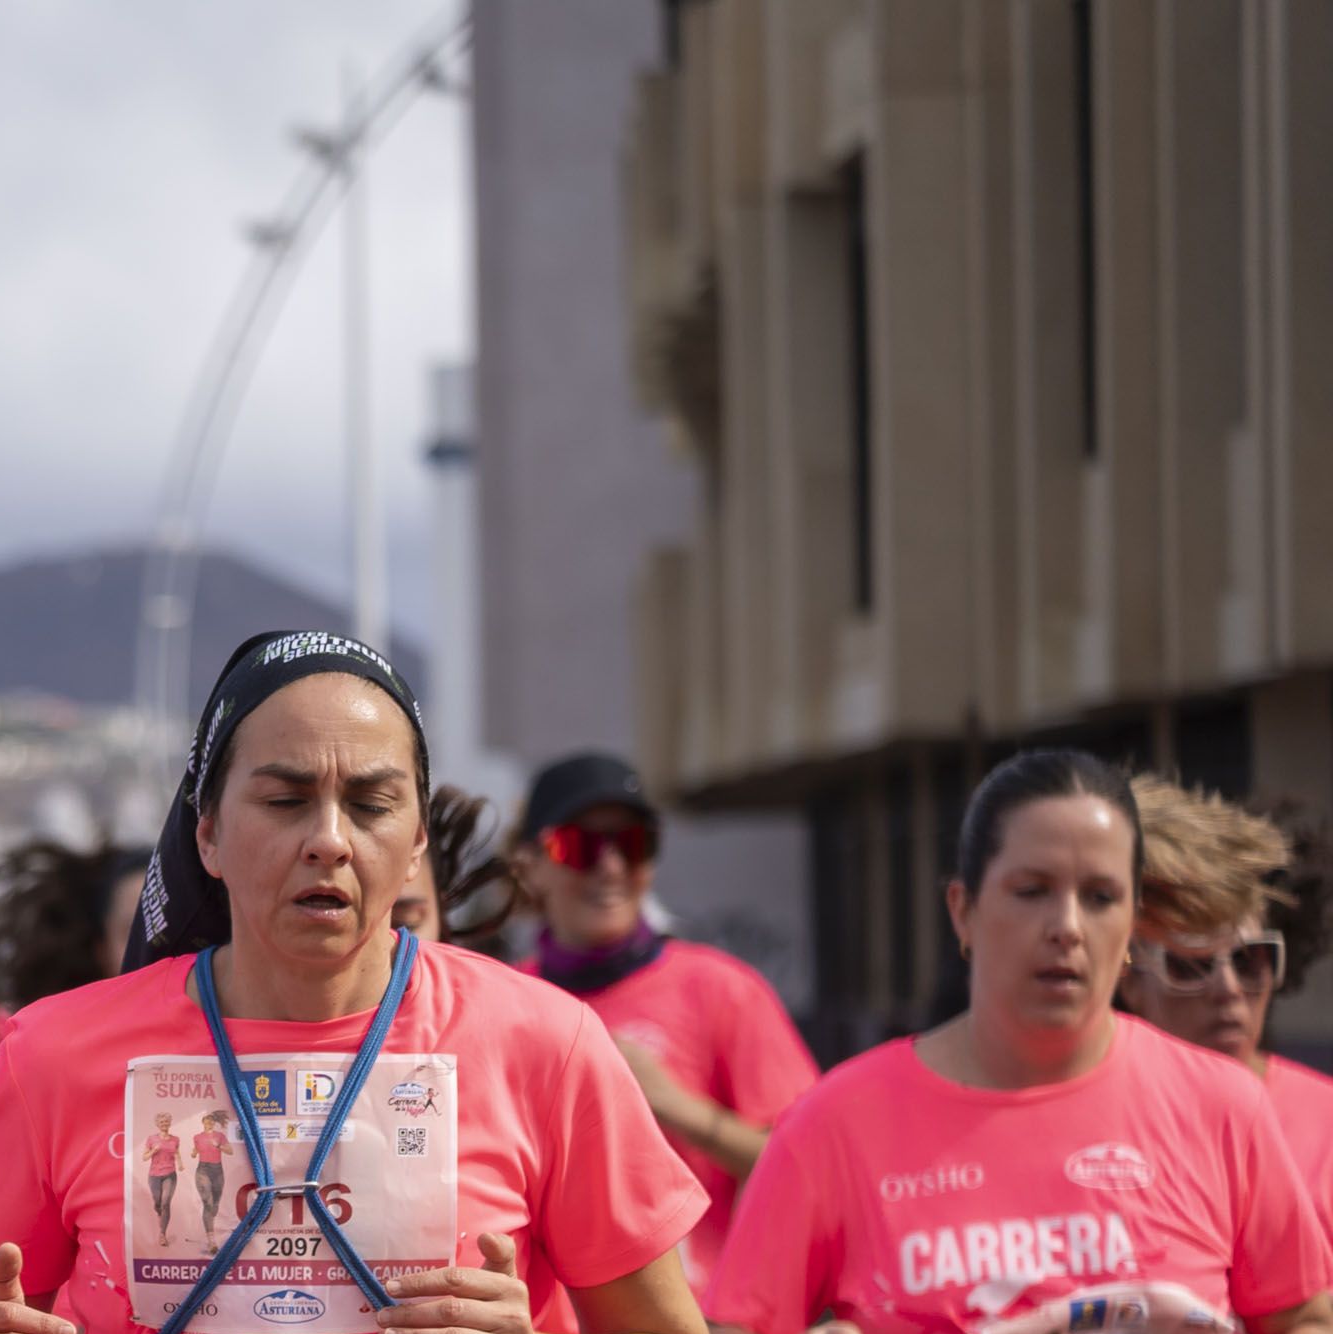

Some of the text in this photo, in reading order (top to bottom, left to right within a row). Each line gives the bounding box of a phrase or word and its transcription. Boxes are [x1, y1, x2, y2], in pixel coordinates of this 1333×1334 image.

[283, 644, 349, 664] SERIES
[153, 1072, 216, 1084] TU DORSAL
[155, 1083, 216, 1099] SUMA
[879, 1162, 986, 1202] OYSHO
[266, 1237, 322, 1258] 2097
[899, 1212, 1139, 1296] CARRERA
[238, 1265, 257, 1280] LA
[262, 1265, 313, 1281] MUJER
[260, 1301, 320, 1315] ASTURIANA
